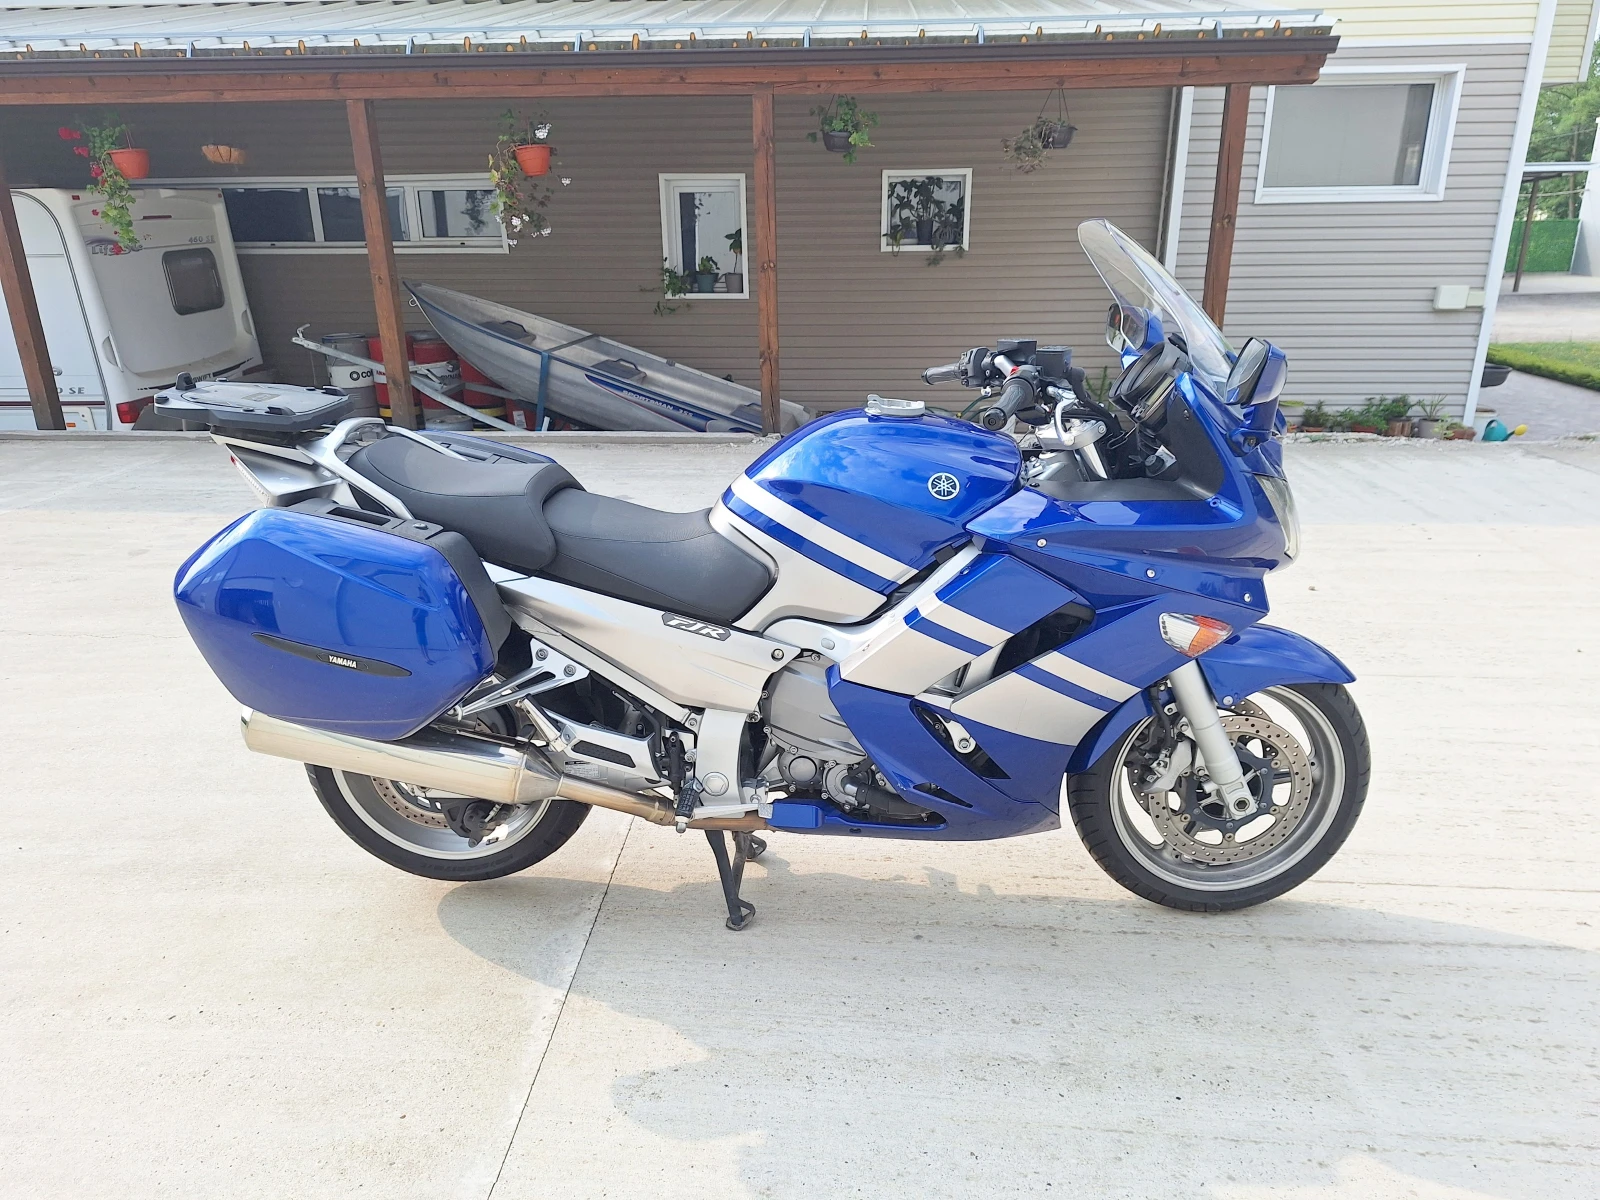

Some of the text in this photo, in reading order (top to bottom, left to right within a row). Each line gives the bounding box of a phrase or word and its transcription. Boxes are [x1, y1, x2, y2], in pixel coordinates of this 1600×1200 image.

[622, 389, 674, 411] SPORTSMAN
[666, 615, 726, 639] FJR
[328, 654, 357, 669] YAMAHA
